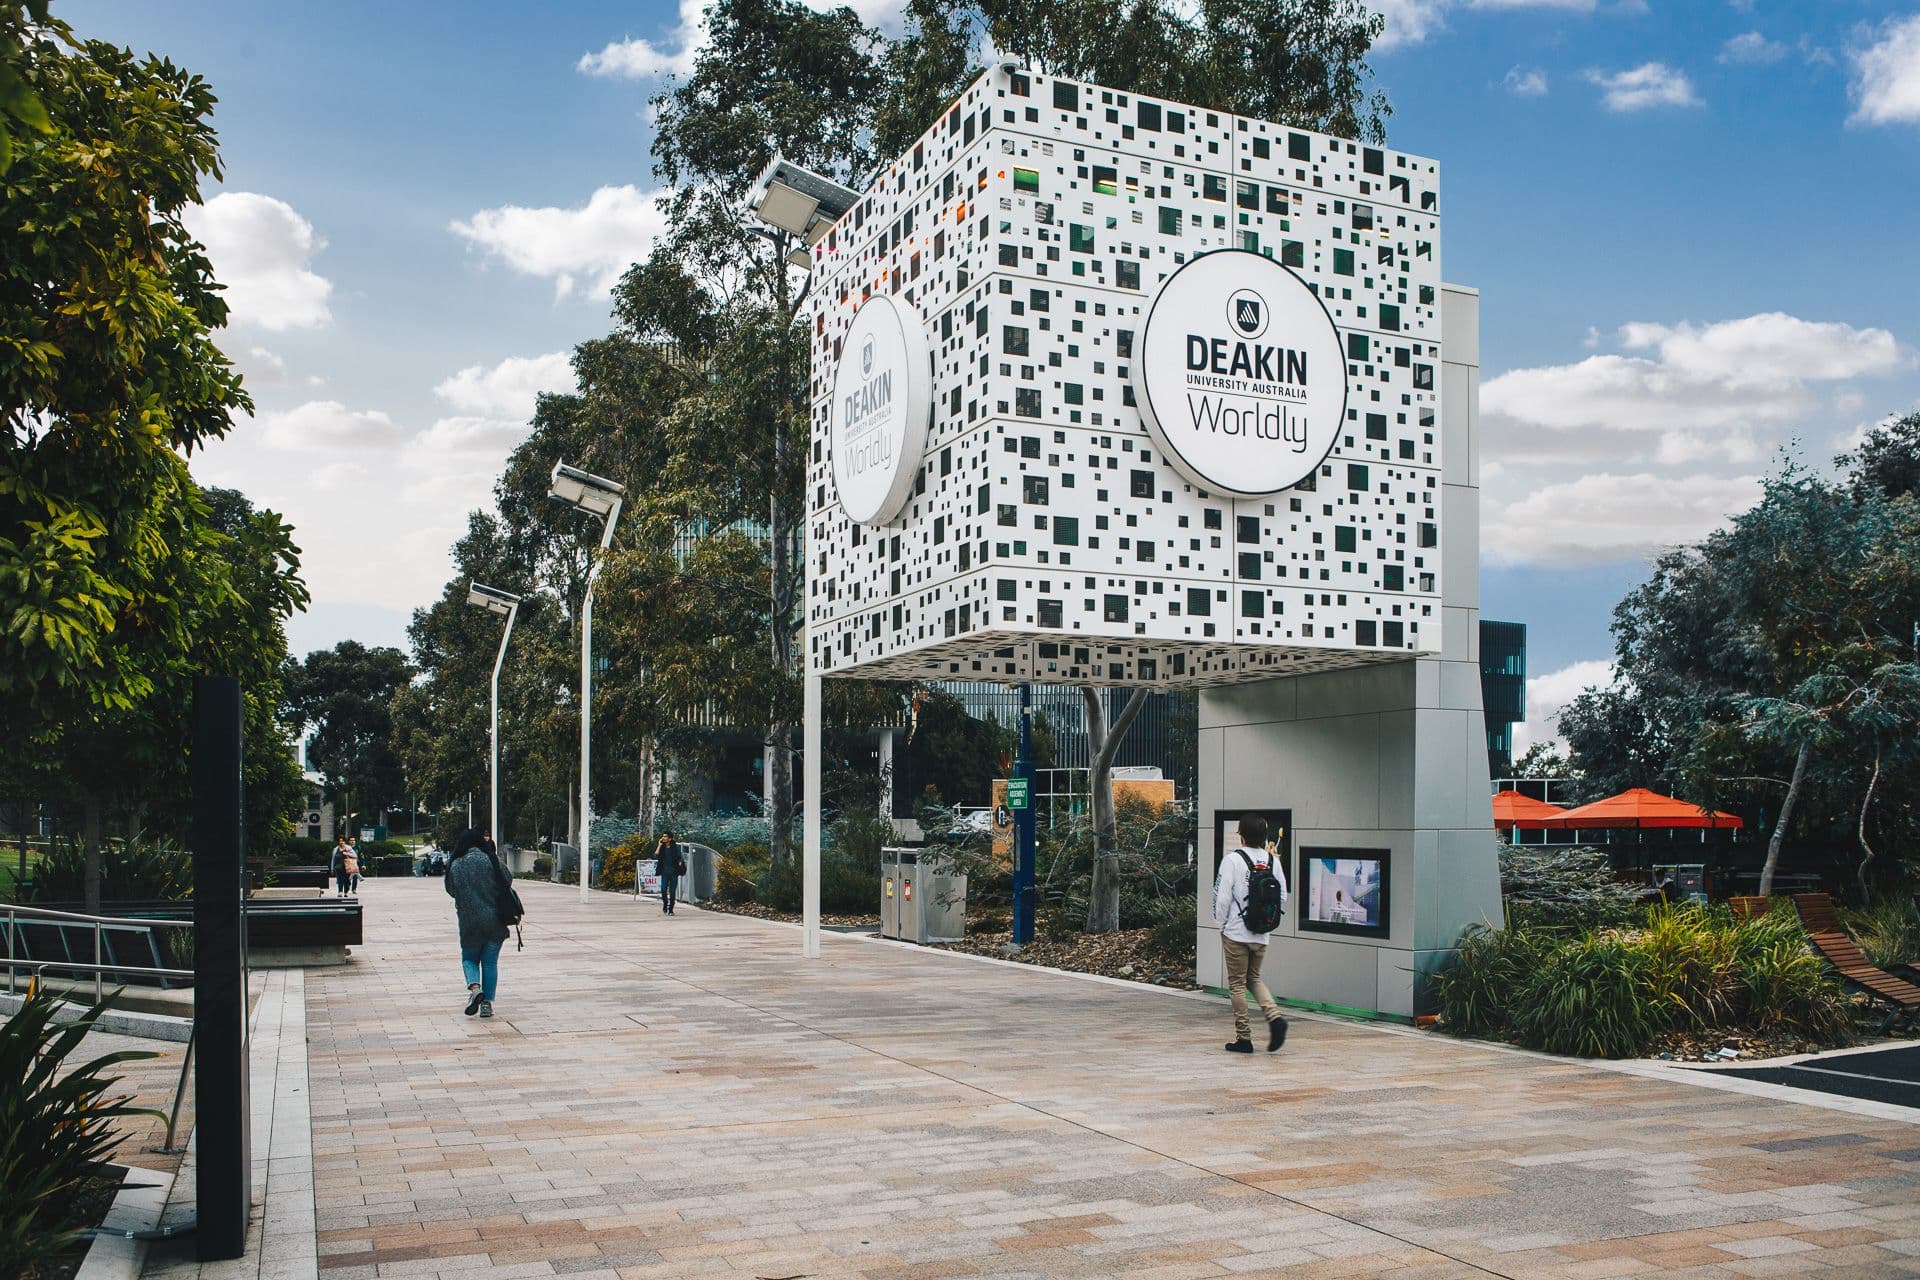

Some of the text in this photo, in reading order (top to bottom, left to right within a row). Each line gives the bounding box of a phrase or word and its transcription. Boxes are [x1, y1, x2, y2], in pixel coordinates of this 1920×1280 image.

[1186, 334, 1307, 386] DEAKIN
[845, 369, 892, 429] DEAKIN
[1187, 374, 1307, 400] UNIVERSITY AUSTRALIA
[868, 407, 892, 427] AUSTRALIA
[1187, 393, 1307, 453] Worldly
[845, 427, 892, 480] Worldly
